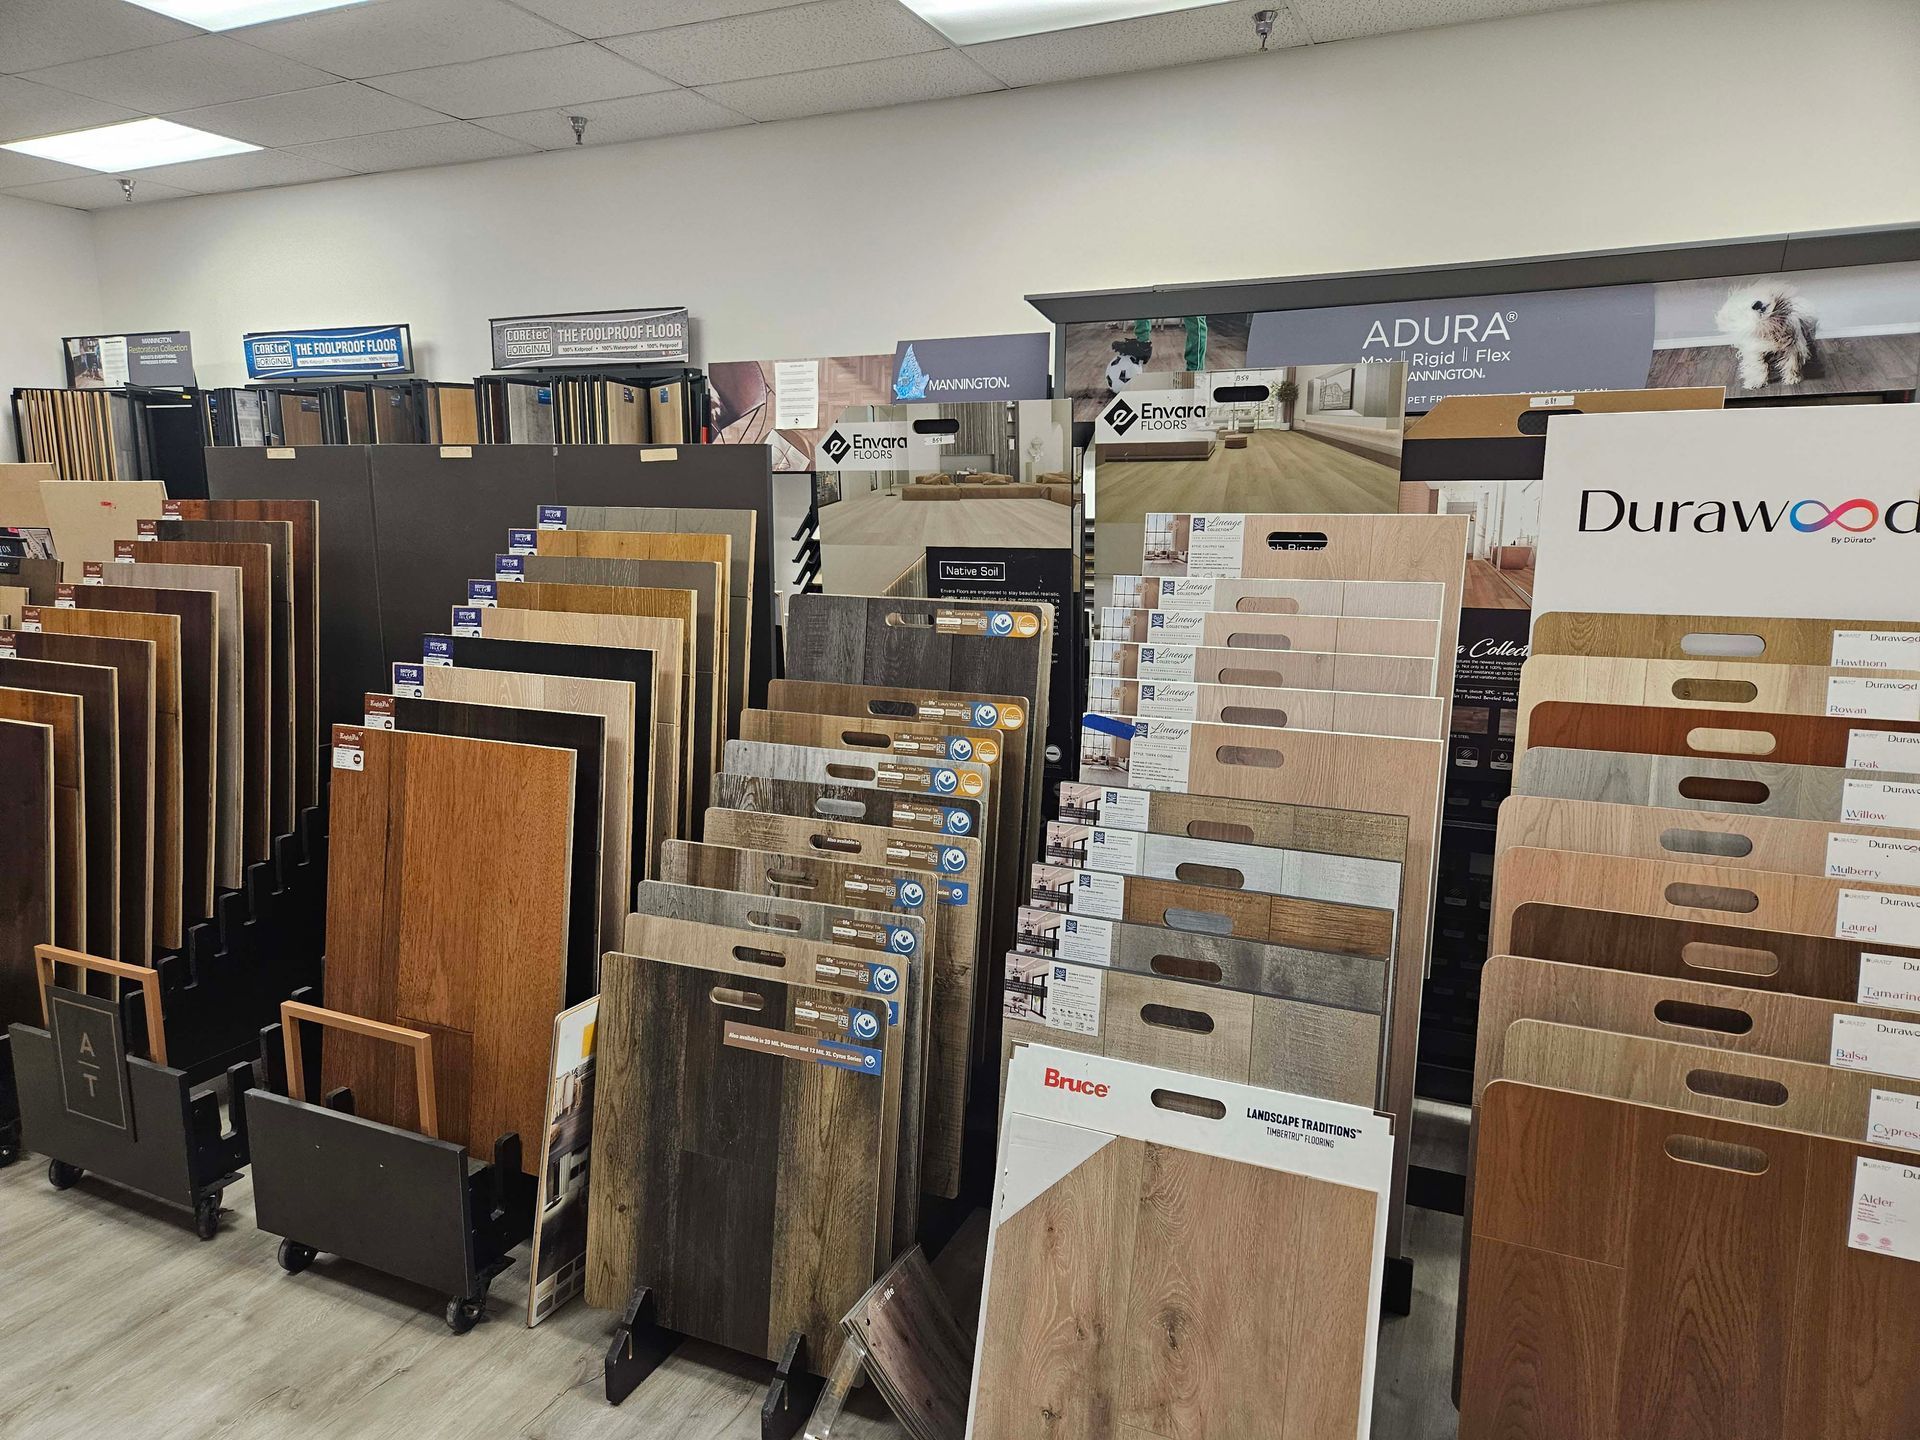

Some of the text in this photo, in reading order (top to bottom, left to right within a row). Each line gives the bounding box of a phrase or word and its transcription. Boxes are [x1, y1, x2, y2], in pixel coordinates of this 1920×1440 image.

[558, 324, 682, 343] THE FOOLPROOF FLOOR
[161, 344, 188, 352] Collection
[295, 338, 398, 356] THE FOOLPROOF FLOOR
[512, 344, 550, 355] ORIGINAL
[613, 343, 638, 351] Waterproof
[260, 357, 292, 367] ORIGINAL
[1412, 350, 1454, 374] Rigid
[1476, 346, 1511, 364] Flex
[1407, 396, 1427, 404] PET
[1140, 404, 1206, 420] Envara
[1140, 419, 1187, 431] FLOORS
[852, 434, 908, 450] Envara
[852, 450, 893, 460] FLOORS
[1207, 516, 1242, 531] Lineage
[1831, 536, 1842, 549] By
[946, 566, 999, 578] Native Soil
[1176, 580, 1213, 596] Lineage
[1166, 612, 1203, 628] Lineage
[1156, 647, 1193, 664] Lineage
[1469, 638, 1530, 658] Collect
[1835, 658, 1887, 668] Hawthorn
[1157, 684, 1195, 702] Lineage
[1830, 705, 1868, 715] Rowan
[1150, 722, 1190, 740] Lineage
[1853, 759, 1879, 769] Teak
[1846, 809, 1888, 821] Willow
[1830, 865, 1881, 880] Mulberry
[1841, 921, 1877, 934] Laurel
[739, 1034, 759, 1043] available
[800, 1045, 809, 1053] and
[1836, 1048, 1868, 1062] Balsa
[1044, 1067, 1109, 1098] Bruce
[1246, 1107, 1300, 1129] LANDSCAPE
[1304, 1136, 1335, 1149] FLOORING
[1859, 1193, 1895, 1208] Alder
